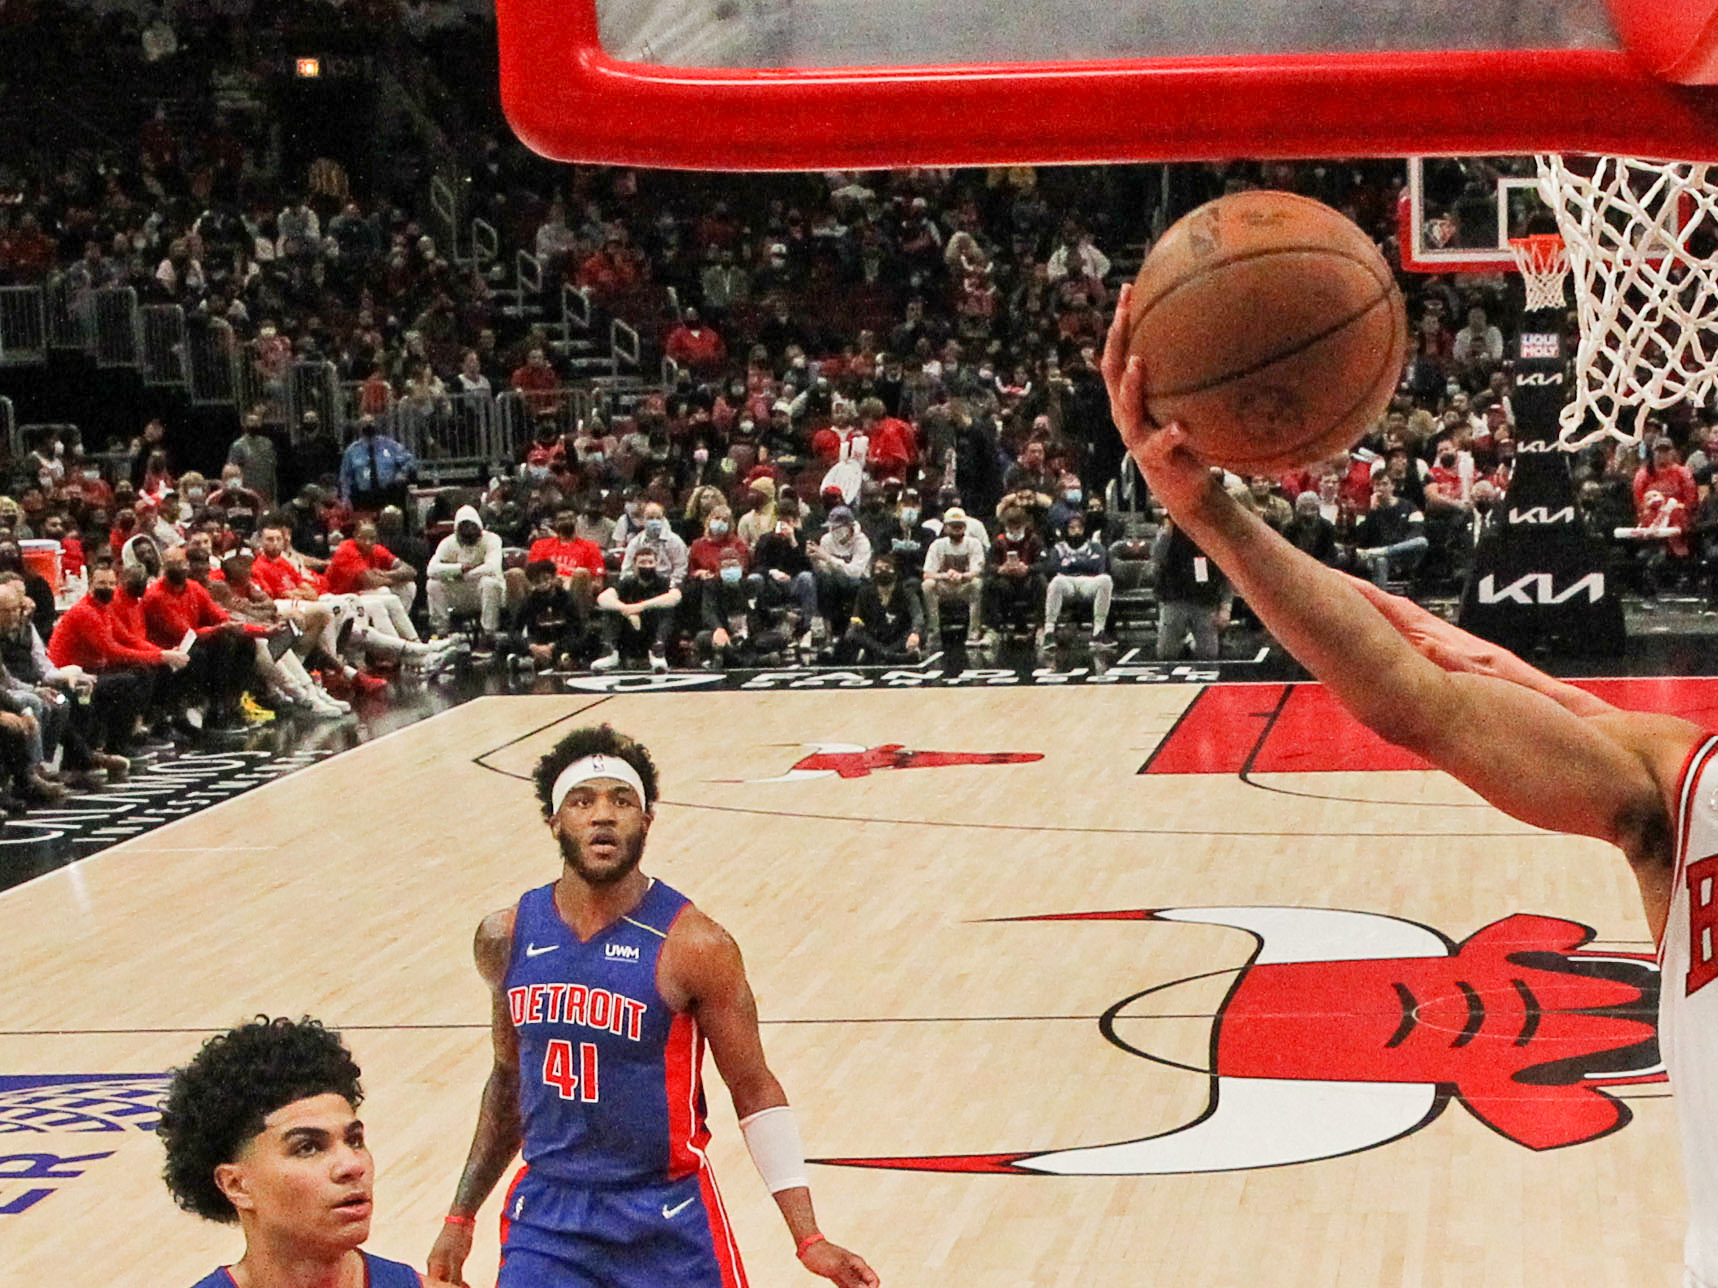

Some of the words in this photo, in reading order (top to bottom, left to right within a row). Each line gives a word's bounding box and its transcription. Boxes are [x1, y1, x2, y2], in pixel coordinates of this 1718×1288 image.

[1509, 506, 1574, 523] KIA
[1478, 572, 1604, 603] KIA
[605, 943, 639, 959] UWM
[507, 983, 647, 1041] DETROIT
[543, 1039, 599, 1103] 41
